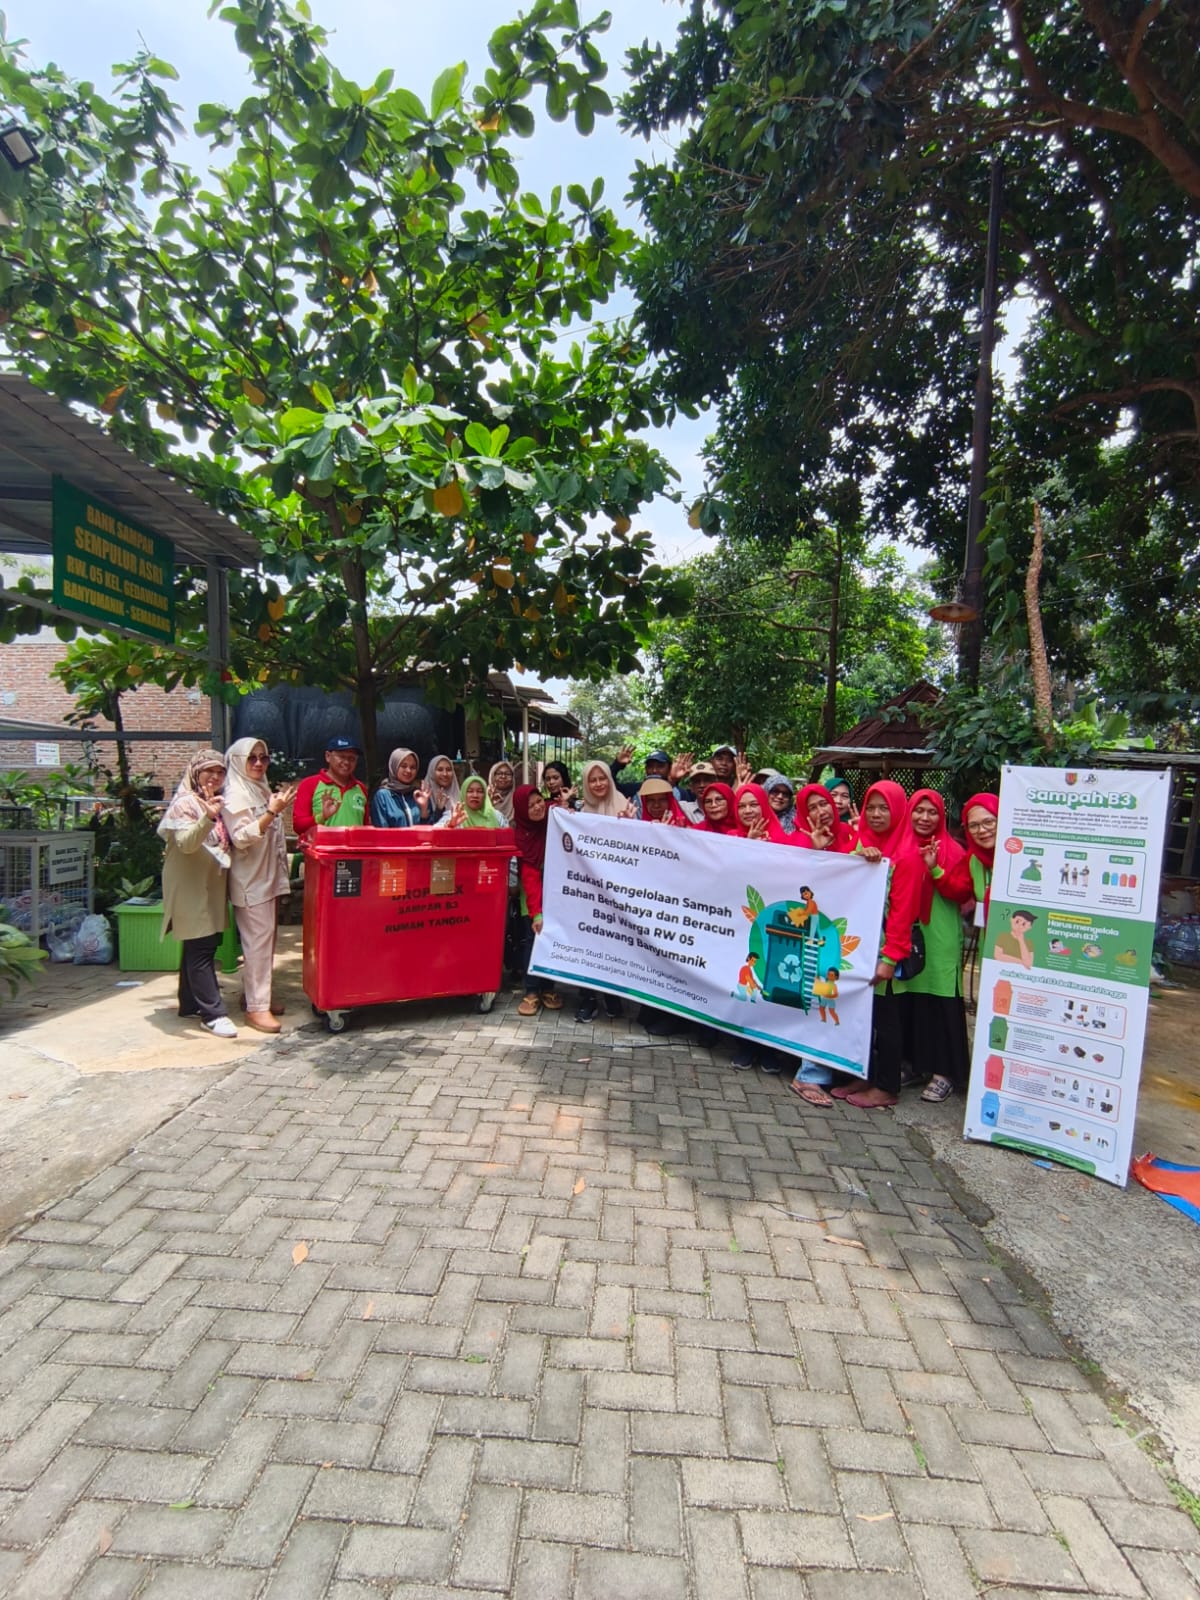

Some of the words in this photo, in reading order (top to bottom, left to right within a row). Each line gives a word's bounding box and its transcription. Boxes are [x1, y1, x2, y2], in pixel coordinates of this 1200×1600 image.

[86, 504, 116, 535] BANK
[75, 526, 137, 574] SEMPULUR
[139, 558, 163, 585] ASRI
[89, 565, 103, 585] 05
[63, 579, 125, 616] BANYUMANIK
[130, 605, 171, 632] SEMARANG
[1026, 787, 1105, 809] Sampah
[1107, 791, 1136, 809] B3
[576, 848, 640, 866] MASYARAKAT
[578, 834, 640, 852] PENGABDIAN
[642, 846, 680, 861] KEPADA
[562, 885, 595, 901] Bahan
[598, 894, 653, 918] Berbahaya
[656, 911, 679, 924] dan
[682, 916, 735, 937] Beracun
[567, 870, 604, 888] Edukasi
[606, 881, 679, 905] Pengelolaan
[682, 897, 732, 918] Sampah
[385, 921, 424, 933] RUMAH
[429, 916, 471, 928] TANGGA
[593, 909, 616, 924] Bagi
[618, 916, 650, 935] Warga
[654, 927, 676, 941] RW
[679, 934, 695, 946] 05
[1047, 928, 1082, 938] Sampah
[1073, 924, 1119, 936] mengelola
[578, 922, 634, 946] Gedawang
[637, 938, 707, 969] Banyumanik
[551, 951, 580, 964] Sekolah
[581, 959, 626, 976] Pascasarjana
[627, 971, 665, 988] Universitas
[666, 983, 708, 1004] Diponegoro
[553, 941, 584, 954] Program
[585, 948, 604, 959] Studi
[605, 954, 628, 966] Doktor
[646, 966, 688, 985] Lingkungan
